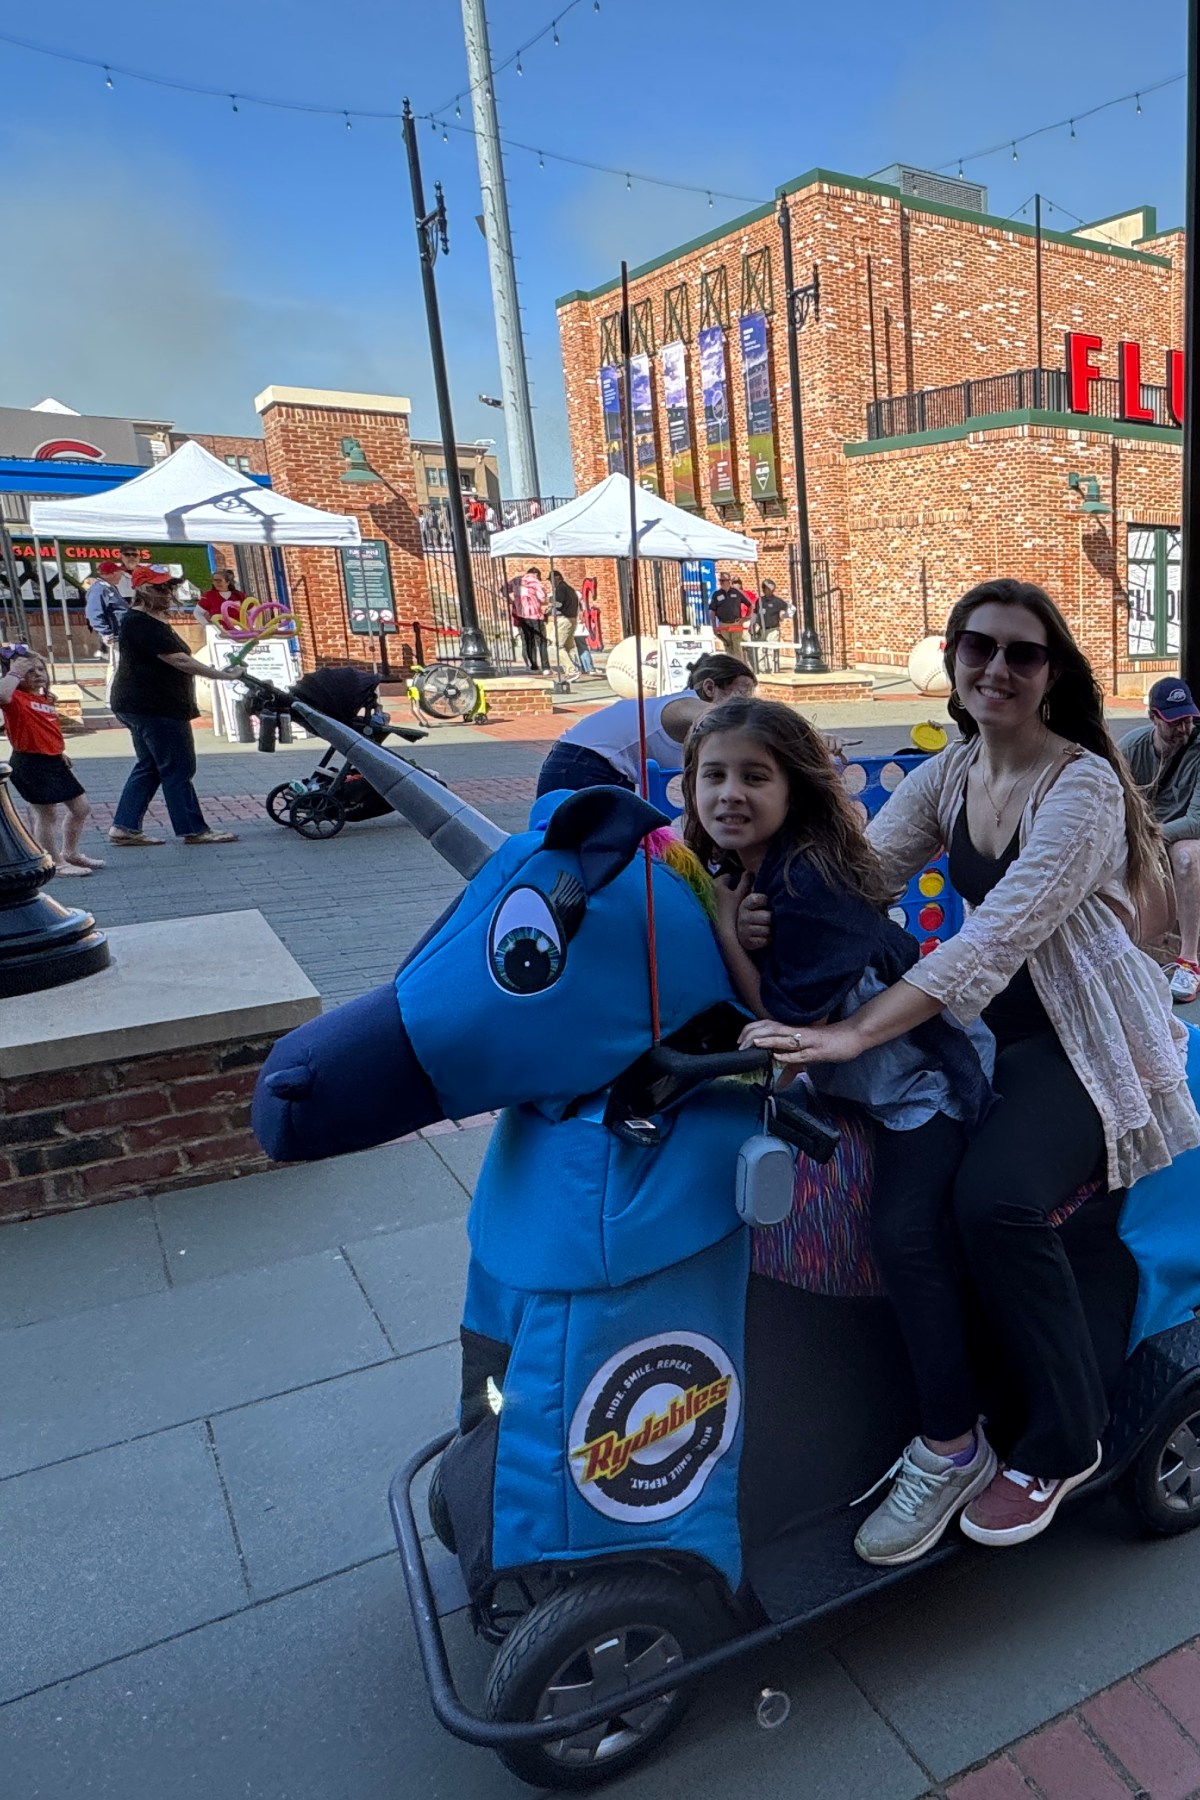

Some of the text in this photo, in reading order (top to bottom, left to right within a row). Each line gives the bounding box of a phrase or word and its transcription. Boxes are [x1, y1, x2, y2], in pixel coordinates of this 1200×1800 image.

[605, 1390, 627, 1419] RIDE.
[656, 1359, 693, 1374] REPEAT.
[571, 1374, 732, 1484] Rydables
[630, 1475, 669, 1490] REPEAT.
